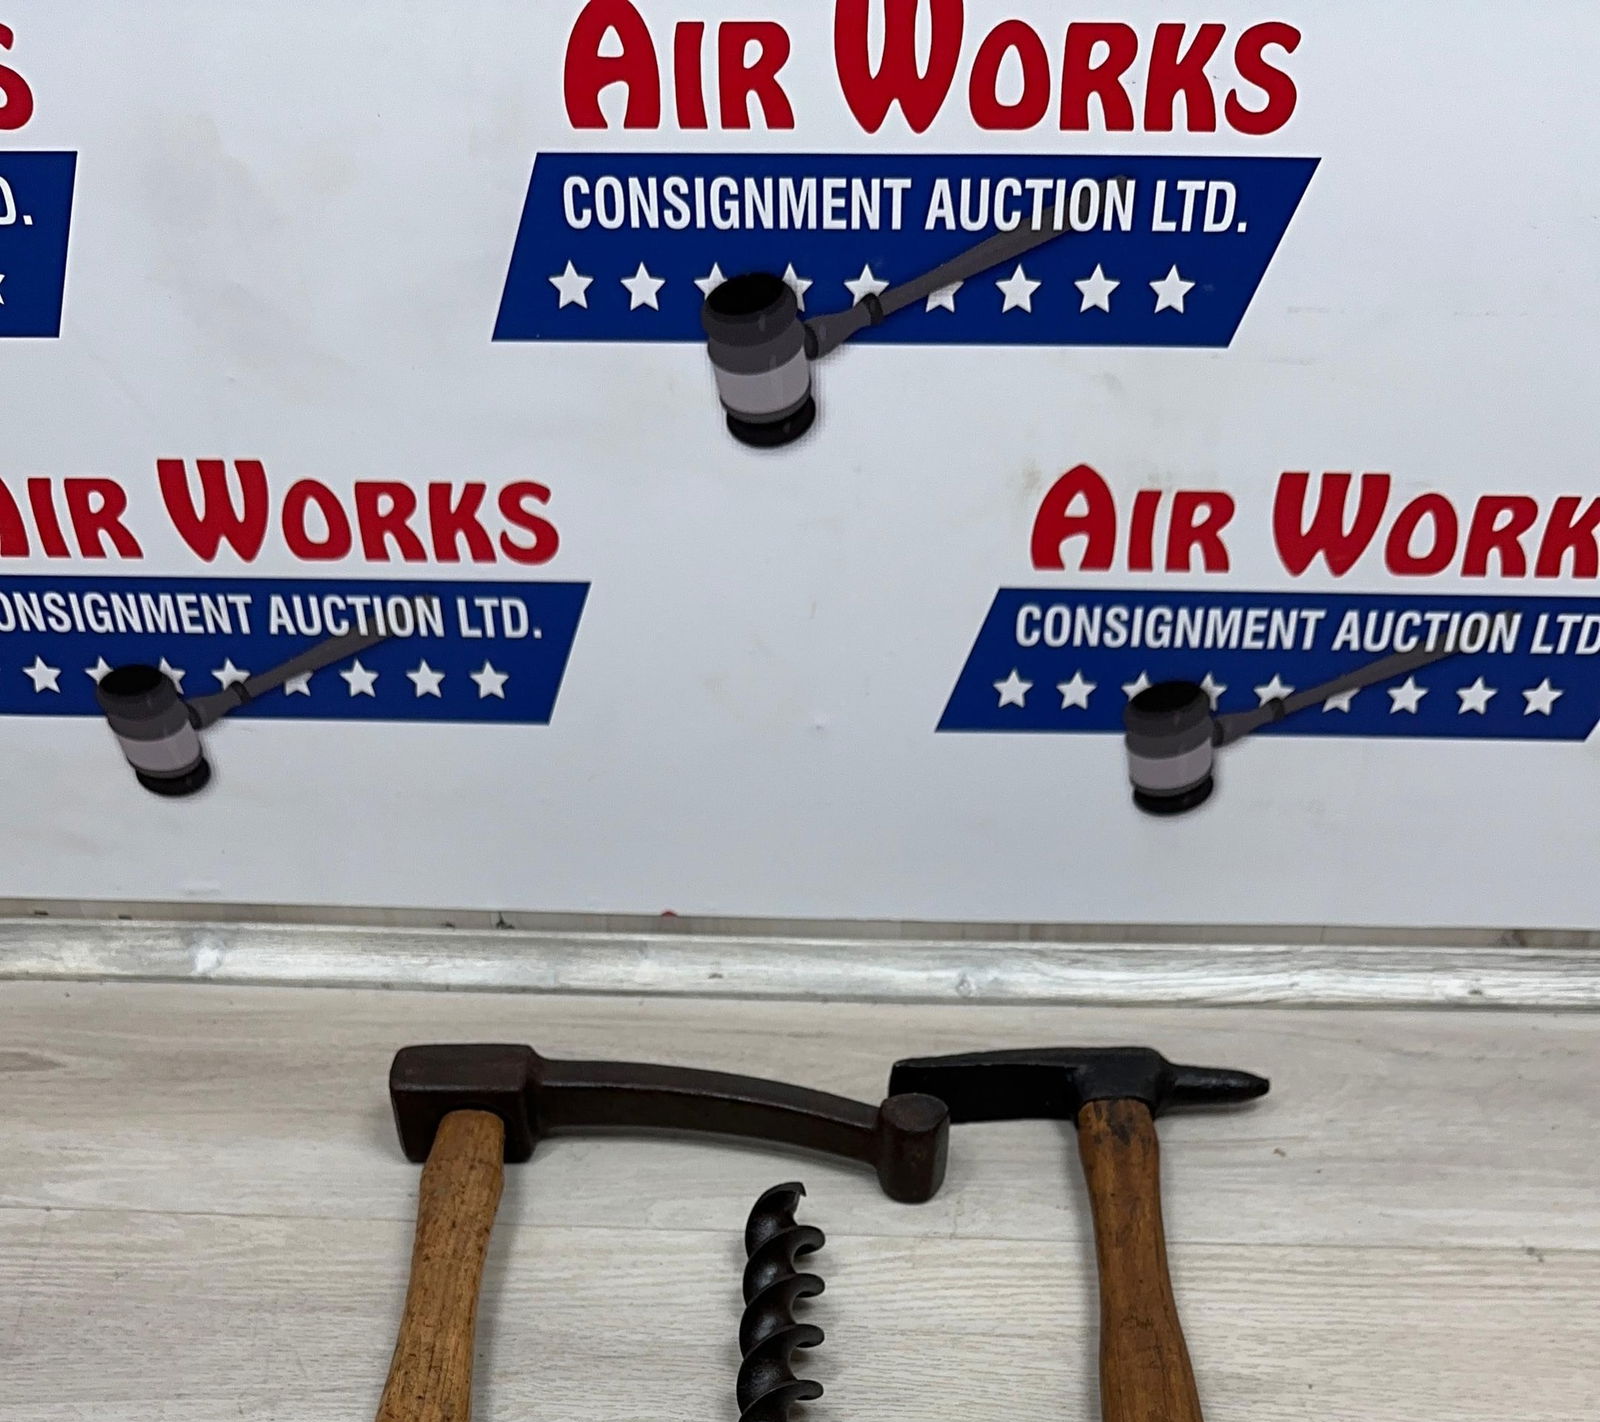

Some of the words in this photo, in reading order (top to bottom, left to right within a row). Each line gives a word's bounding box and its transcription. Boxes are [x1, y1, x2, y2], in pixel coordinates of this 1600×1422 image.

[563, 0, 795, 130] AIR
[833, 0, 1303, 136] WORKS
[562, 175, 912, 232] CONSIGNMENT
[924, 177, 1136, 233] AUCTION
[1151, 178, 1248, 234] LTD.
[156, 458, 560, 566] WORKS
[1030, 462, 1235, 573] AIR
[1272, 472, 1600, 579] WORK
[269, 594, 444, 638] AUCTION
[457, 597, 543, 639] LTD.
[1015, 604, 1327, 651] CONSIGNMENT
[1332, 610, 1522, 654] AUCTION
[1529, 613, 1600, 656] LTD
